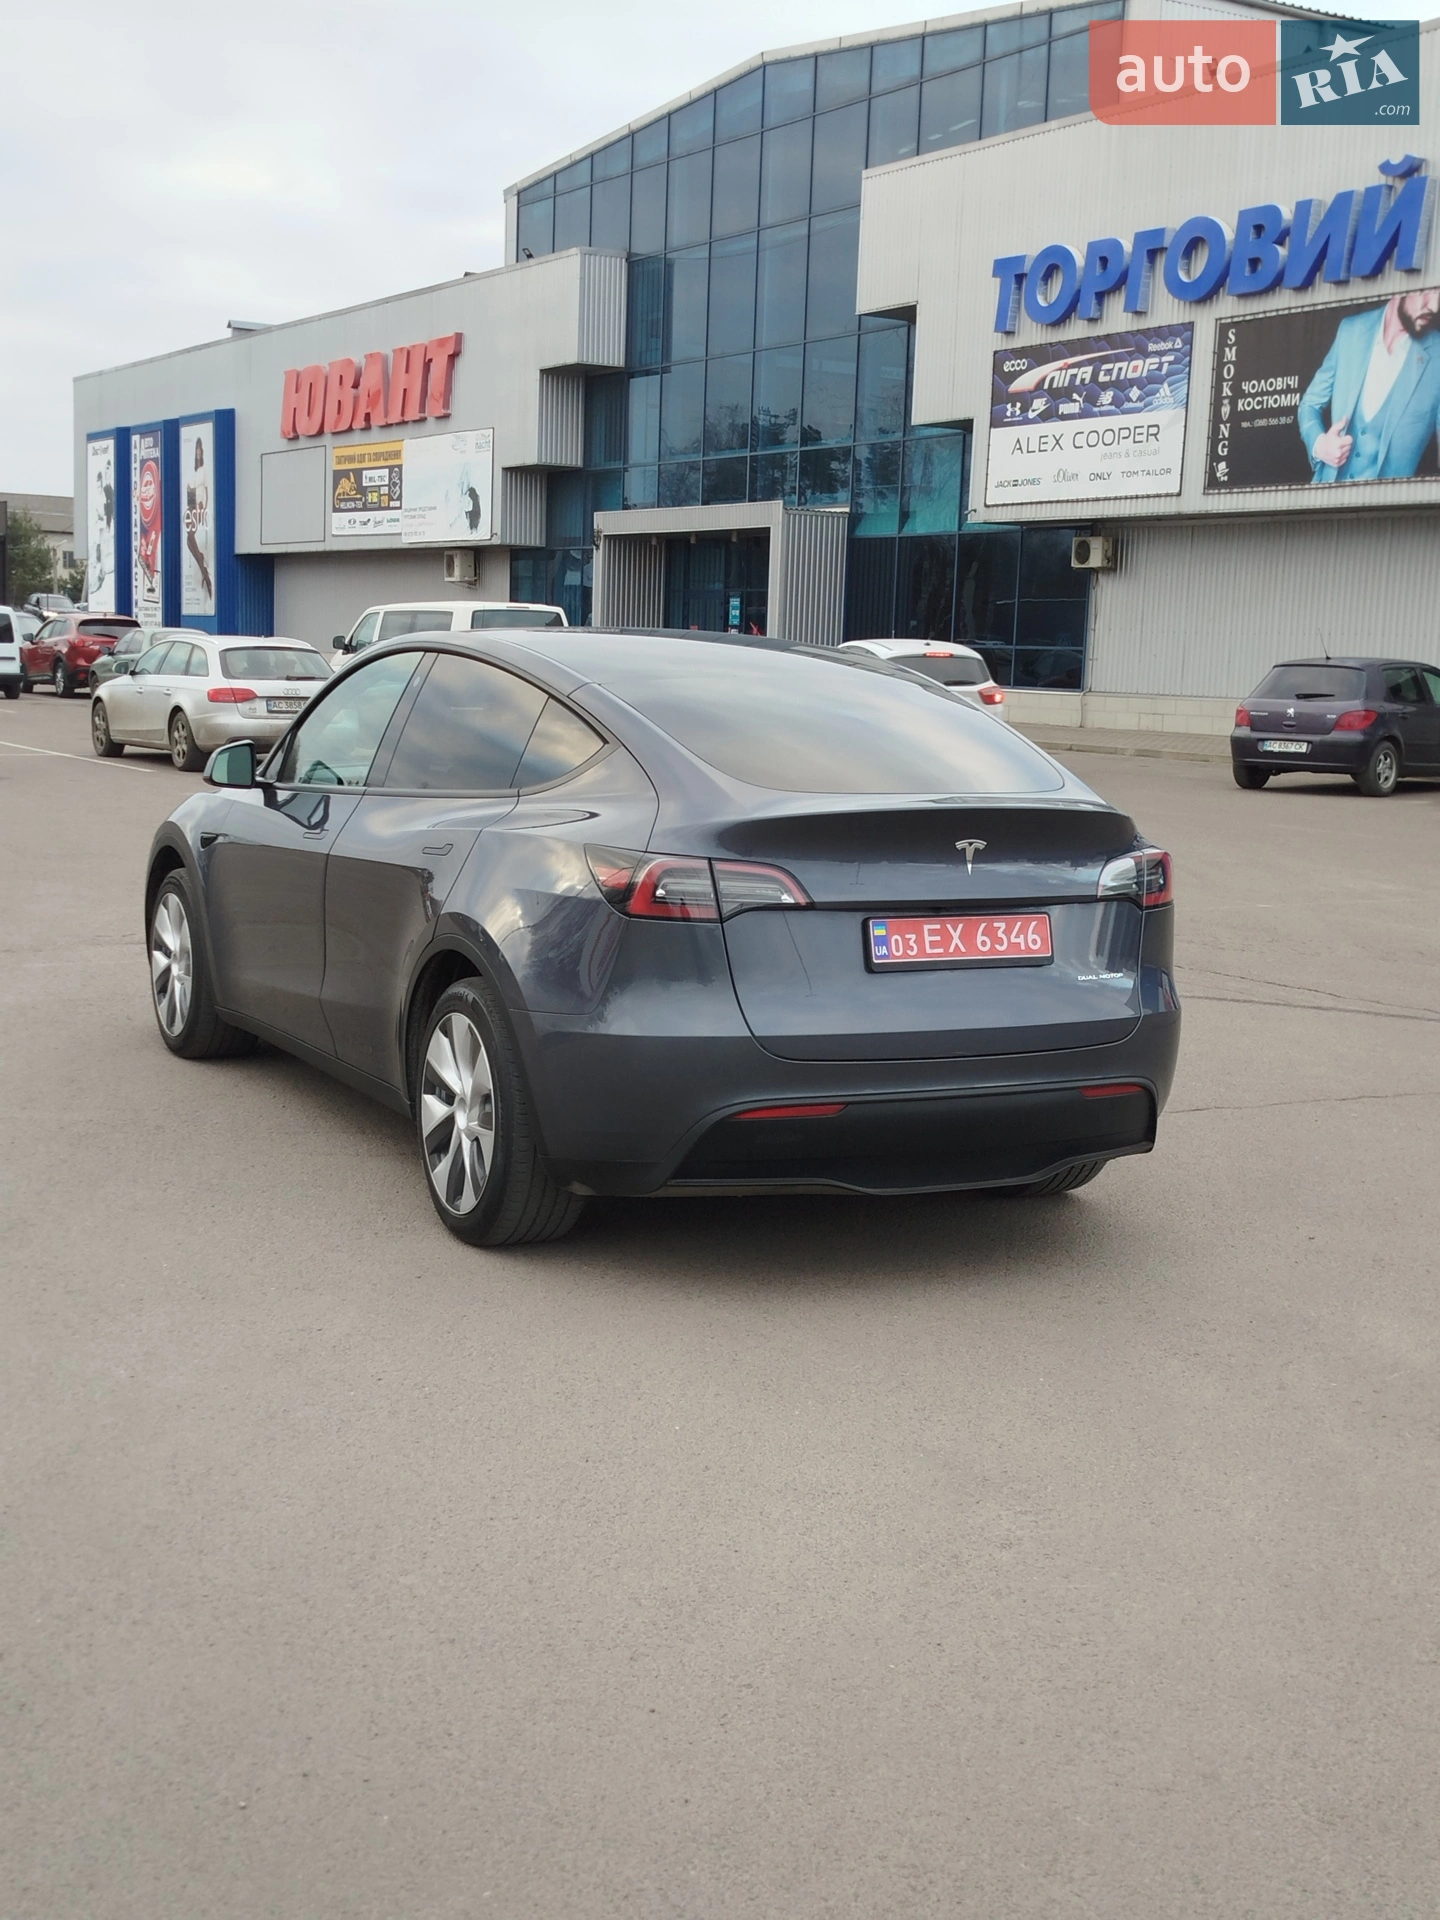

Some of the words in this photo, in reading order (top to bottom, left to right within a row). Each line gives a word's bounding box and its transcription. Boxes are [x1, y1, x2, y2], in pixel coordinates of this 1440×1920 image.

[992, 154, 1435, 334] ТОРГОВИЙ
[1148, 340, 1174, 352] Reebok
[1003, 359, 1028, 372] ecco
[281, 332, 463, 439] ЮВАНТ
[1241, 375, 1299, 394] ЧОЛОВІЧІ
[1237, 393, 1300, 412] КОСТЮМИ
[1011, 433, 1064, 455] ALEX
[1072, 424, 1160, 449] COOPER
[1100, 451, 1122, 462] jeans
[1124, 449, 1130, 458] &
[1132, 447, 1160, 458] casual
[1089, 472, 1112, 482] ONLY
[1121, 470, 1139, 478] TOM
[1140, 467, 1172, 477] TAILOR
[272, 701, 284, 709] AC
[1267, 741, 1278, 749] AC
[1294, 742, 1305, 751] CK
[891, 933, 918, 957] 03
[923, 923, 966, 954] EX
[976, 920, 1042, 953] 6346
[875, 944, 888, 957] UA
